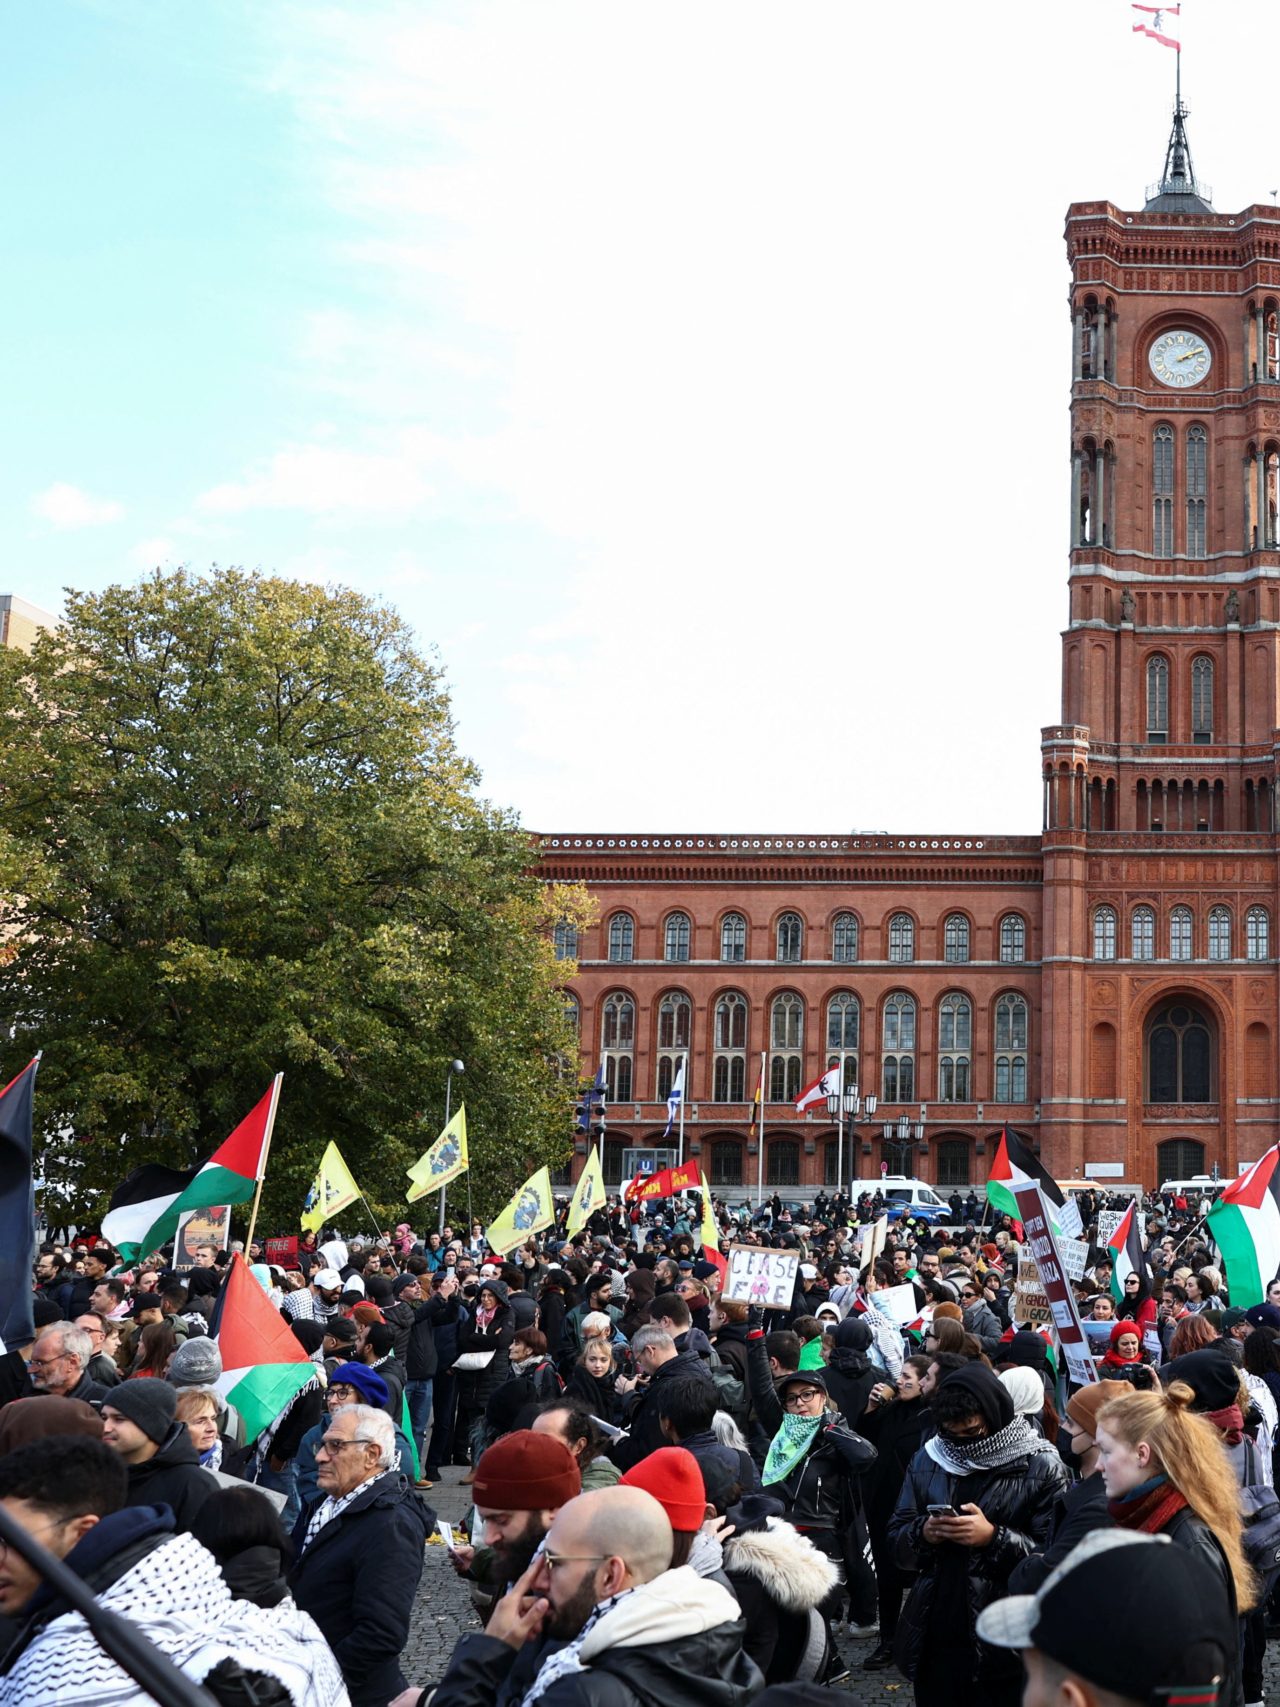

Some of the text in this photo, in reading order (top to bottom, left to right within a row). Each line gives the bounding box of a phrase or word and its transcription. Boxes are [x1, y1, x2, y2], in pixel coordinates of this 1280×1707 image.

[642, 1161, 650, 1171] U
[267, 1240, 288, 1252] FREE
[732, 1250, 796, 1279] CEASE
